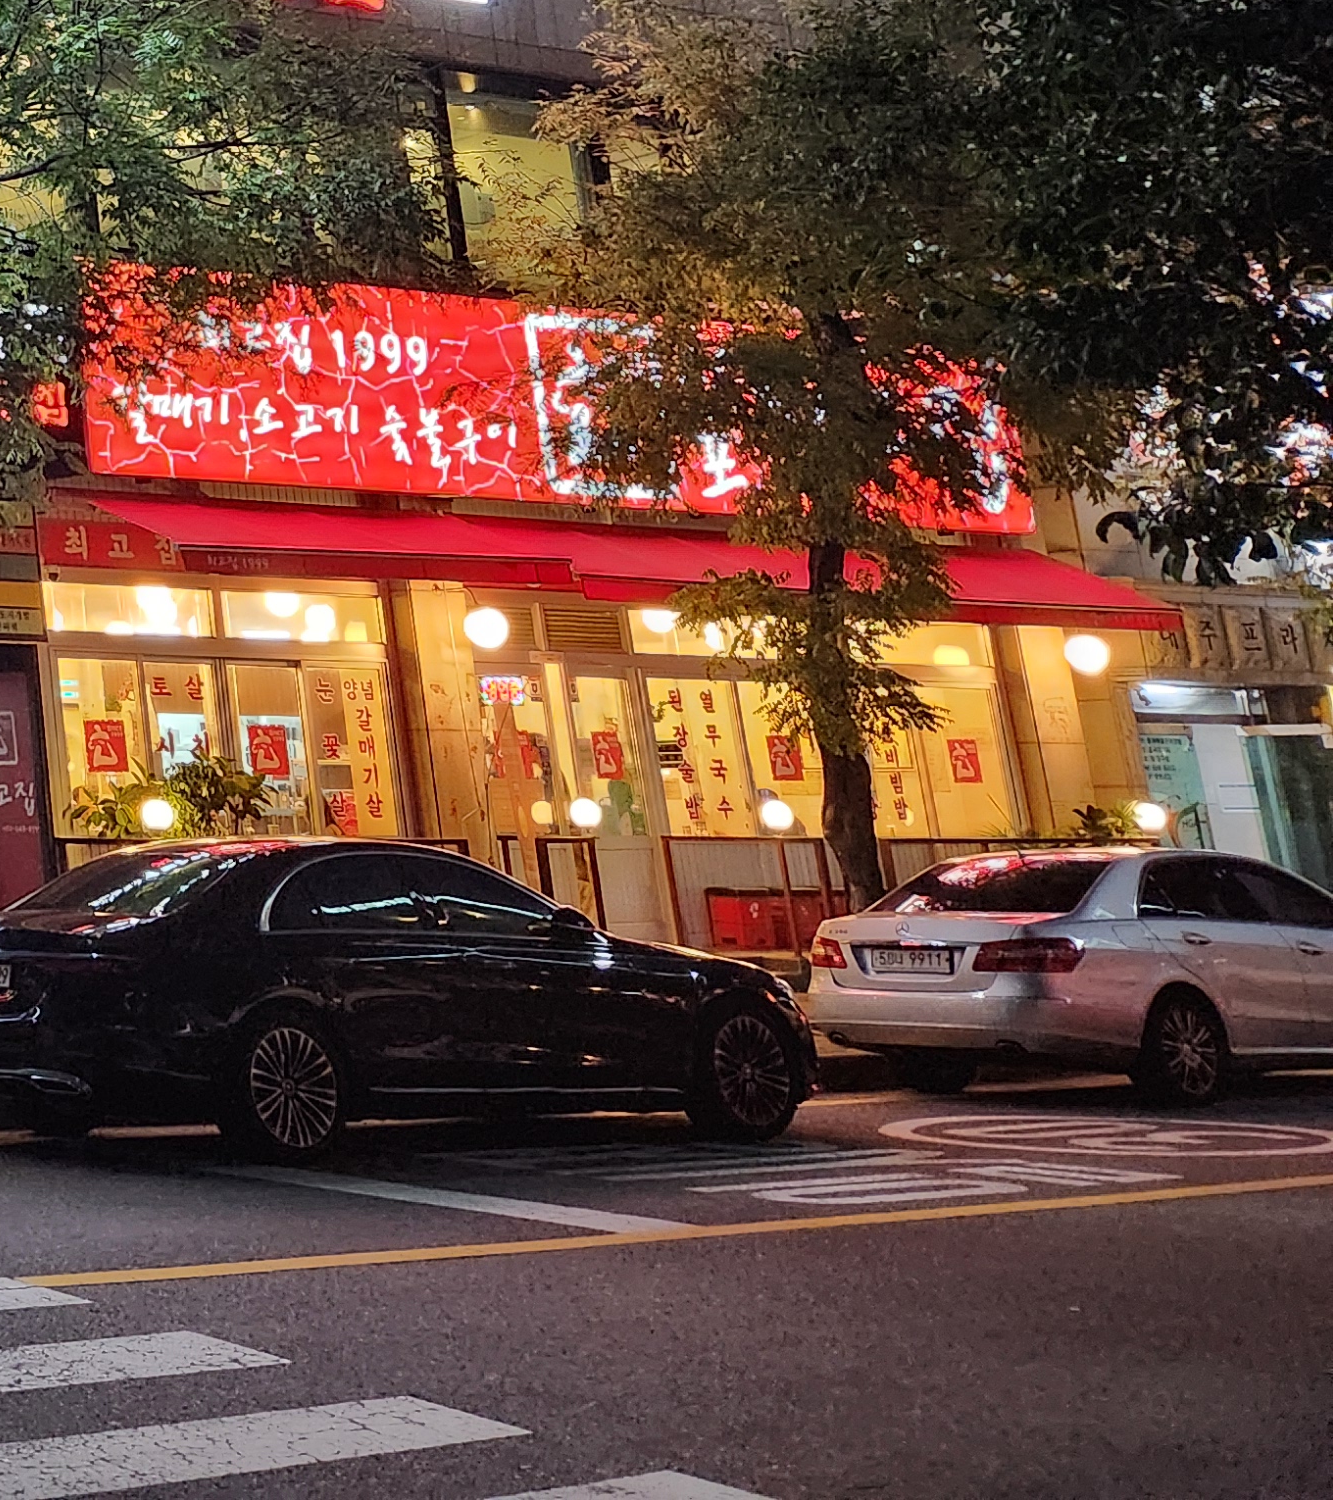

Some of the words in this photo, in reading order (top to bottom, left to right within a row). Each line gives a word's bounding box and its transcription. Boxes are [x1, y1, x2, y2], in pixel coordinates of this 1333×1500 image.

[333, 329, 427, 376] 1999
[253, 397, 360, 438] 소고기
[909, 951, 942, 967] 9911
